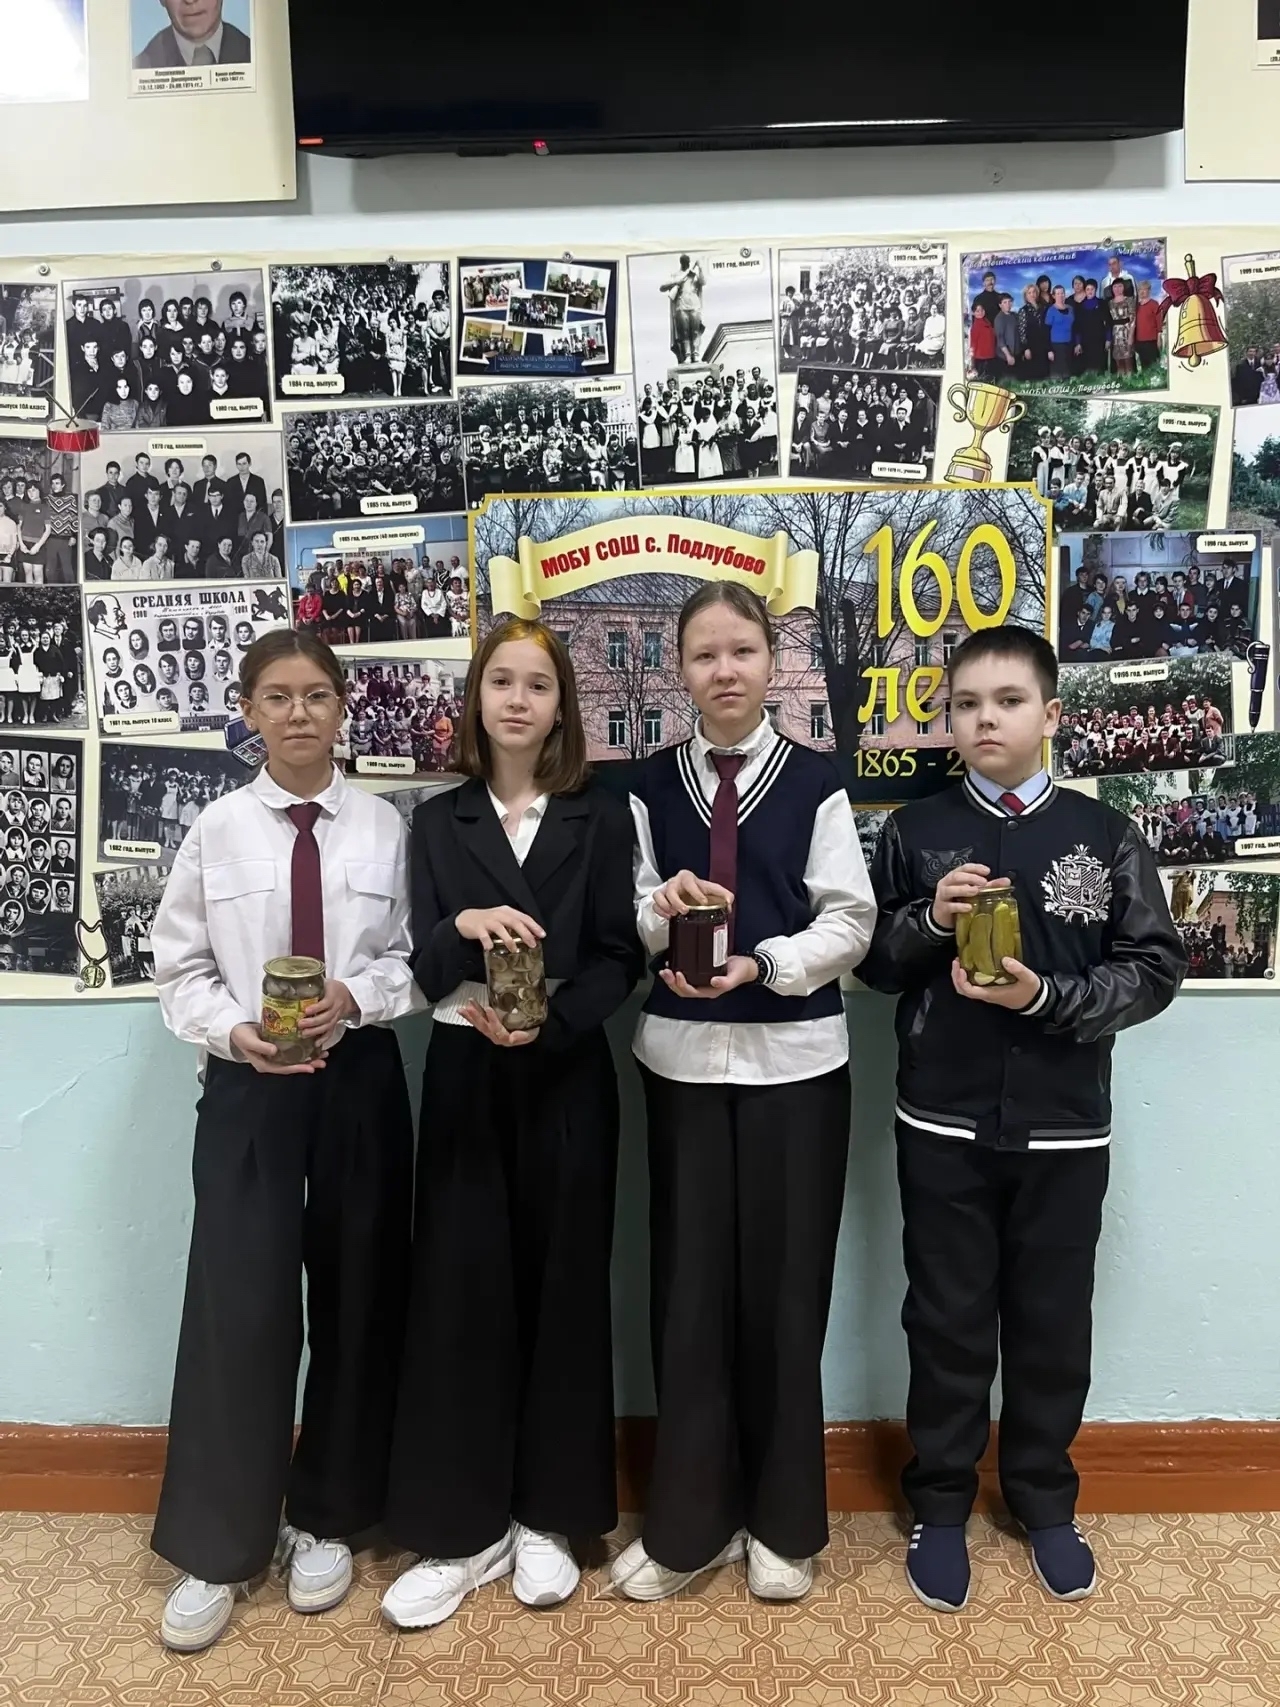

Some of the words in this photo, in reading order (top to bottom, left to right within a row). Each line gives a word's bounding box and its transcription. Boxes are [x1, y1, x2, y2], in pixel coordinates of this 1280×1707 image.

[540, 545, 591, 579] МОБУ
[595, 534, 640, 561] СОШ
[645, 536, 661, 553] с.
[667, 533, 766, 576] Подлубово
[863, 519, 1017, 638] 160
[132, 593, 192, 608] СРЕДНЯЯ
[198, 590, 246, 605] ШКОЛА
[857, 666, 944, 723] ле
[853, 748, 918, 777] 1865
